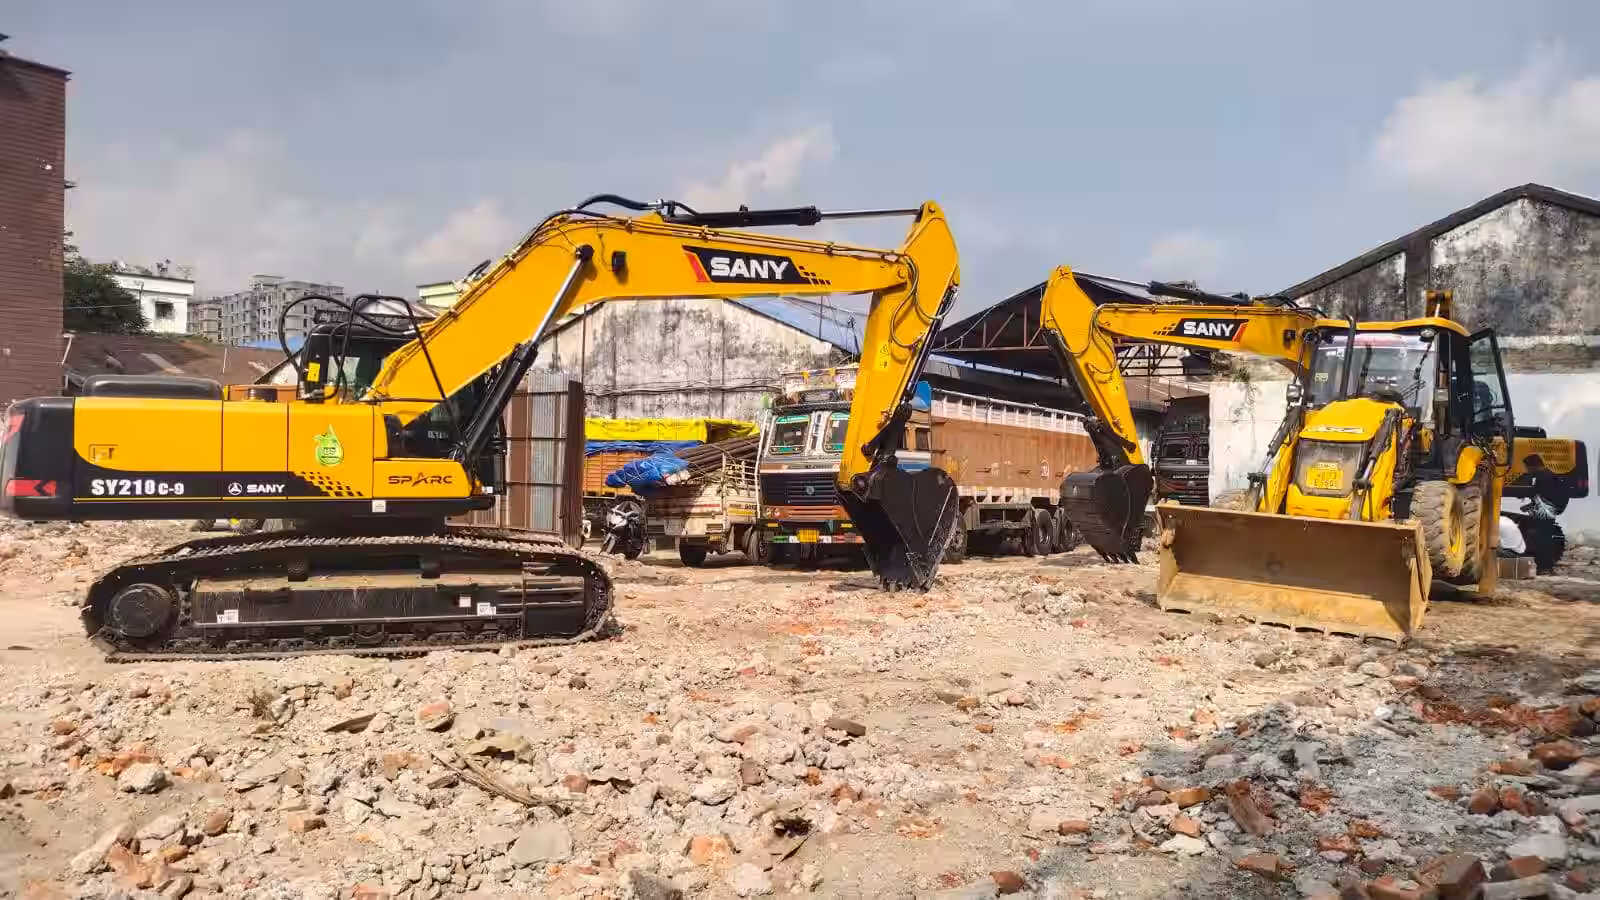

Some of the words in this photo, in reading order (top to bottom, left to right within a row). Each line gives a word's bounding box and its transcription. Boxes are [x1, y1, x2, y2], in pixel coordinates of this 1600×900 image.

[710, 256, 789, 280] SANY
[1183, 321, 1235, 337] SANY
[388, 472, 453, 488] SPARC
[246, 483, 286, 494] SANY
